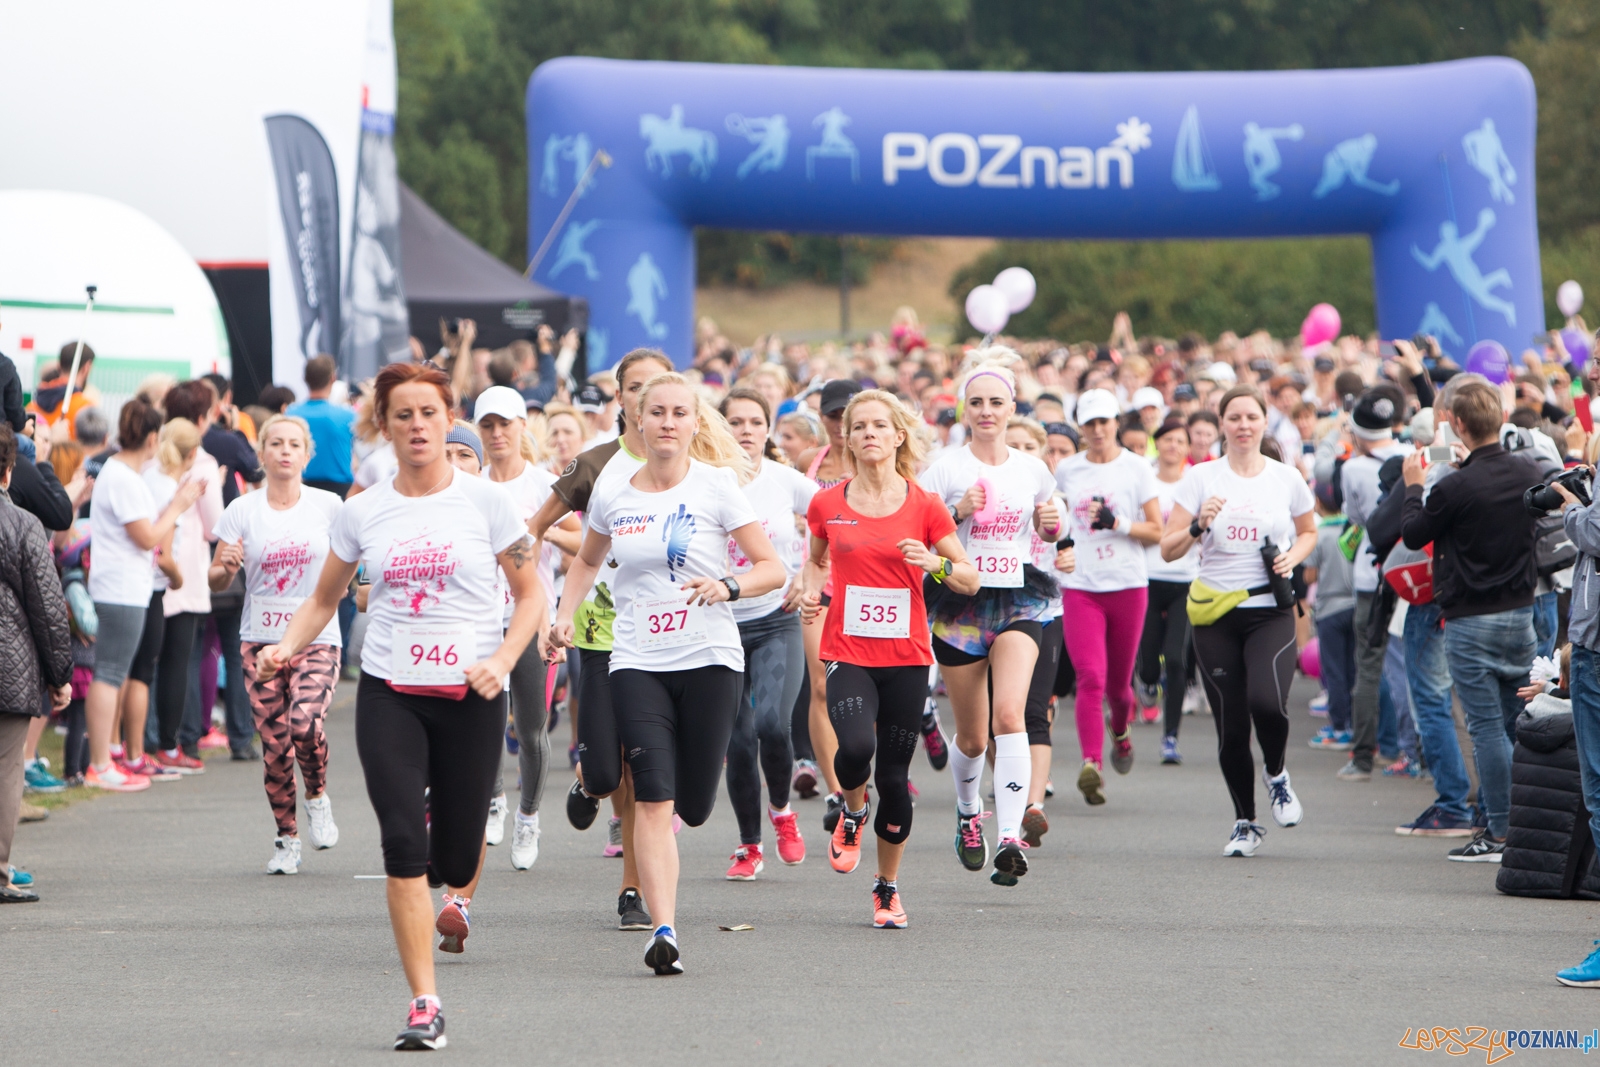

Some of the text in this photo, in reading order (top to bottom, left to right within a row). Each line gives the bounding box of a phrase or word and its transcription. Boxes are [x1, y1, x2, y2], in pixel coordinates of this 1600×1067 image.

[614, 525, 647, 537] TEAM
[1226, 525, 1259, 542] 301
[267, 548, 307, 560] zawsze
[391, 551, 447, 567] zawsze
[975, 555, 1019, 574] 1339
[648, 609, 688, 635] 327
[859, 604, 897, 623] 535
[410, 644, 459, 666] 946
